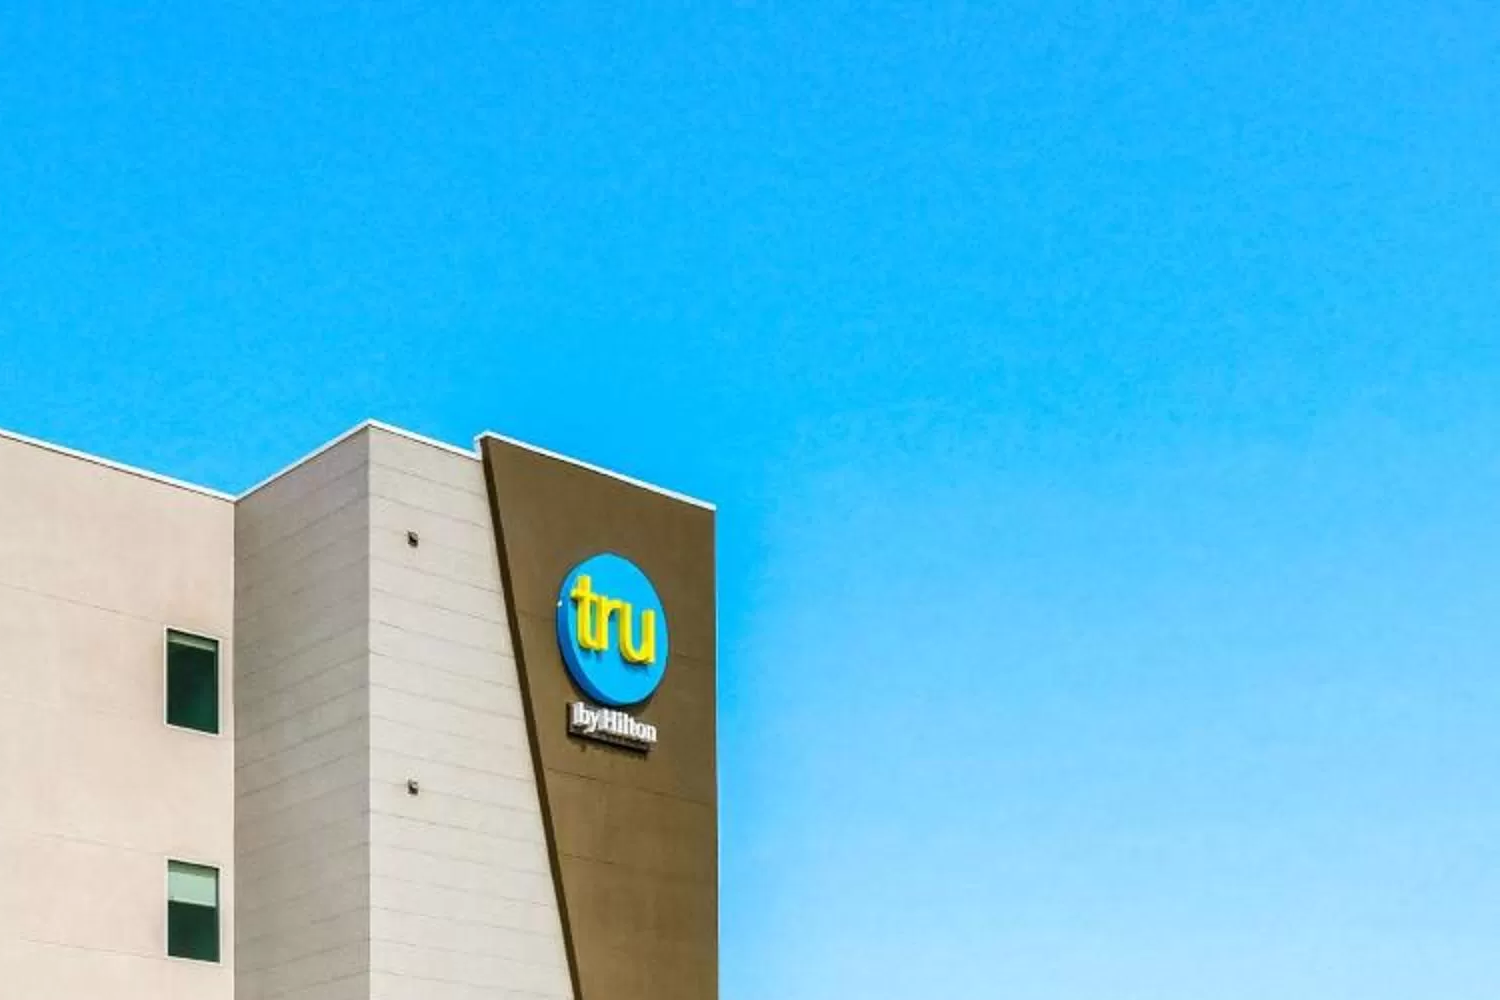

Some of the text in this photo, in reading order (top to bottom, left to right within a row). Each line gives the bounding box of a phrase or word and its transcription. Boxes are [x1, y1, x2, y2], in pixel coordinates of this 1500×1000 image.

[569, 574, 656, 665] tru
[571, 701, 657, 743] by Hilton
